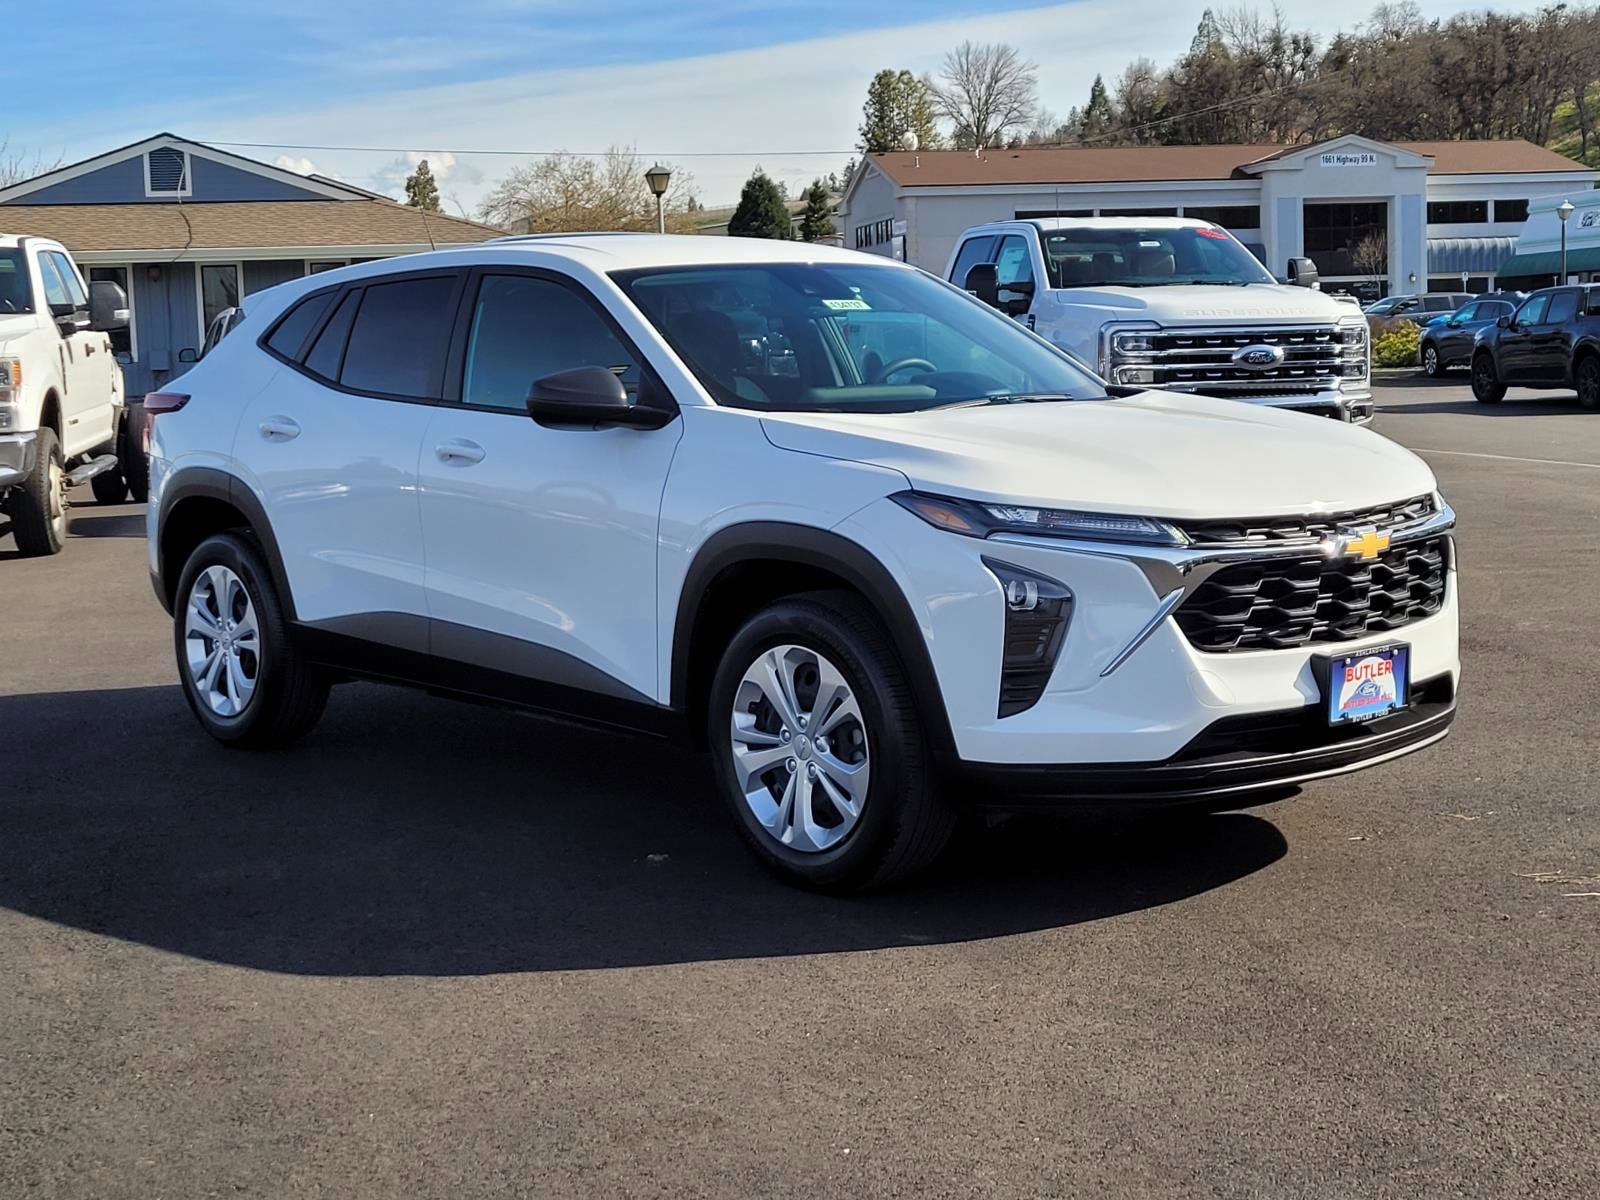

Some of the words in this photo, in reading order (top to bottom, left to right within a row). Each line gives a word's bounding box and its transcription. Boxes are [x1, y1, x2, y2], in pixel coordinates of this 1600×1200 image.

[1322, 154, 1335, 164] 1661
[1336, 154, 1360, 165] Highway
[1361, 154, 1368, 163] 99
[1248, 351, 1274, 363] Ford
[1345, 660, 1393, 682] BUTLER
